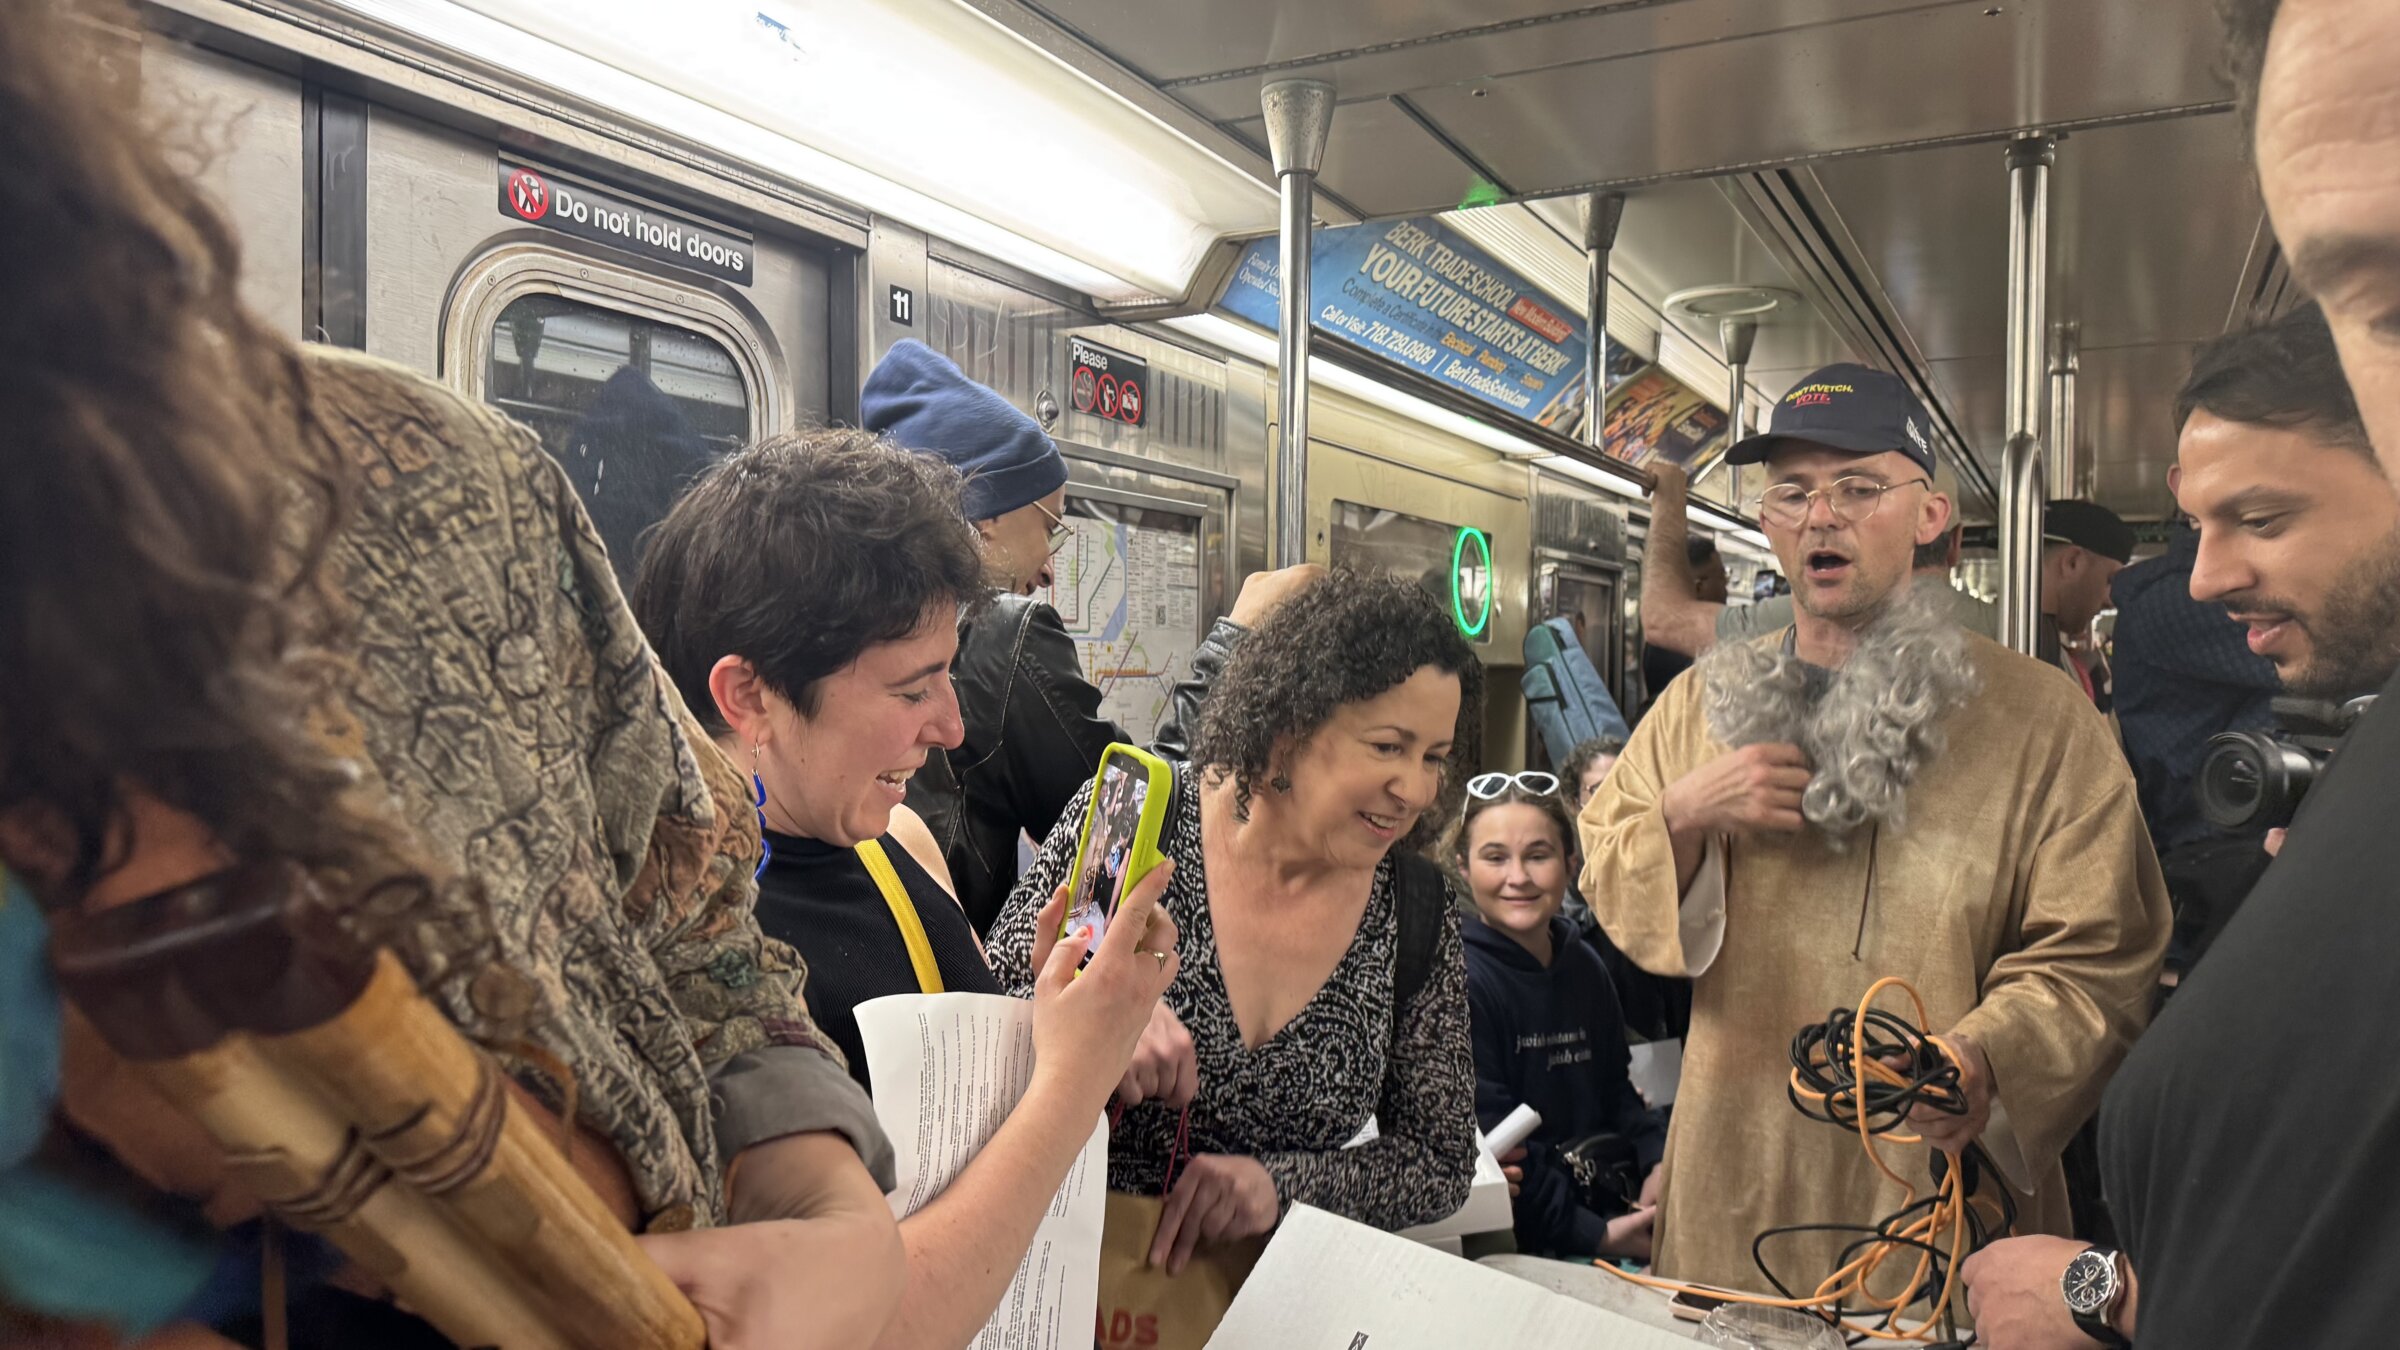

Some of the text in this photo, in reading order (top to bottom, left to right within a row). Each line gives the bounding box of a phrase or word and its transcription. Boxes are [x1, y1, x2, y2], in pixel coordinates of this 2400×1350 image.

[555, 189, 744, 272] Do not hold doors
[1384, 220, 1517, 312] BERK TRADE SCHOOL
[892, 290, 909, 320] 11
[1360, 242, 1423, 298] YOUR
[1408, 275, 1480, 328] FUTURE
[1465, 308, 1526, 353] STARTS
[1511, 336, 1541, 360] AT
[1073, 343, 1108, 370] Please
[1362, 320, 1437, 365] 718.729.0909
